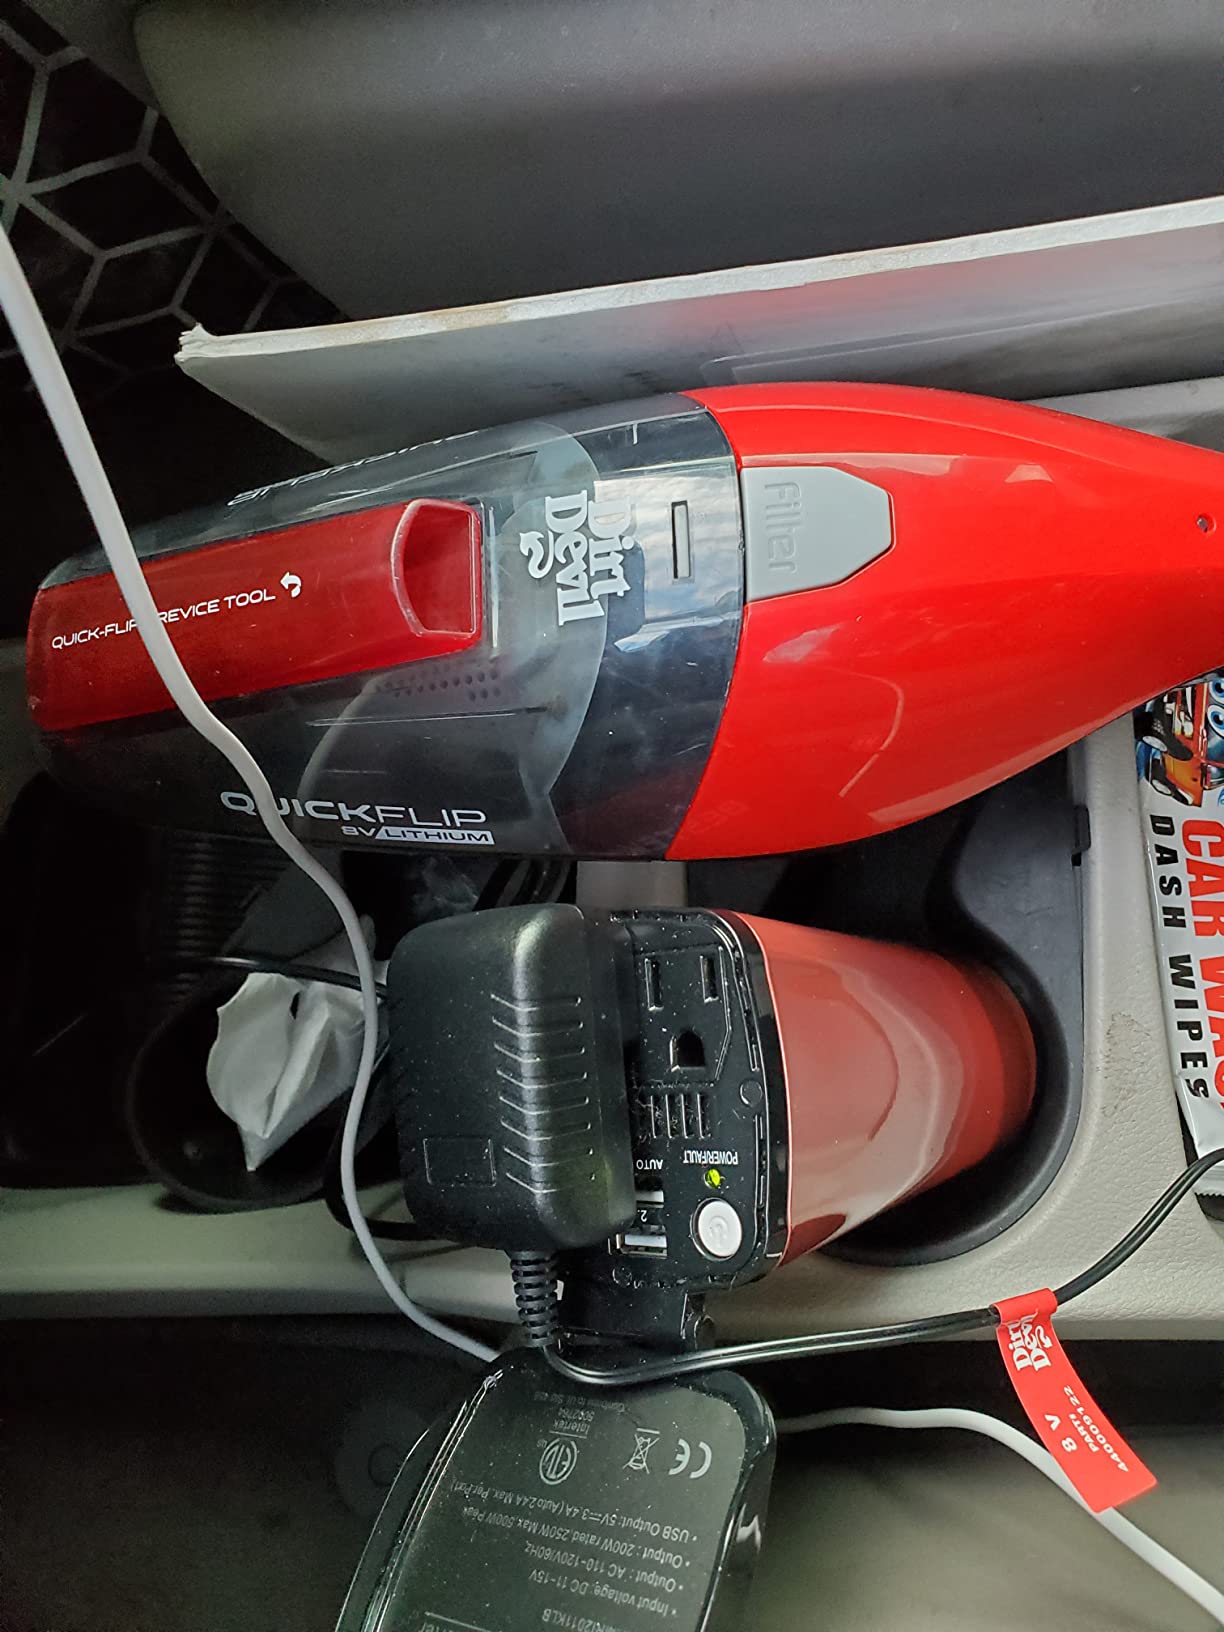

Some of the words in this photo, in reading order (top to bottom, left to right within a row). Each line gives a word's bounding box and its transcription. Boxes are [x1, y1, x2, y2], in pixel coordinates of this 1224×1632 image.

[764, 481, 802, 575] Filter
[588, 499, 635, 597] Dirt
[545, 490, 605, 626] Devil
[157, 599, 220, 624] REVICE
[224, 588, 276, 609] TOOL
[341, 825, 378, 837] 8V
[384, 828, 490, 843] LITHIUM
[1181, 819, 1224, 937] CAR
[1149, 814, 1187, 928] DASH
[1168, 954, 1210, 1098] WIPES
[636, 1159, 664, 1171] AUTO
[553, 1419, 591, 1435] Intertek
[1044, 1413, 1061, 1432] V
[1063, 1384, 1129, 1472] 440009122
[1061, 1437, 1078, 1453] 8
[662, 1527, 690, 1544] USB
[601, 1537, 636, 1557] 200W
[607, 1563, 626, 1580] AC
[570, 1578, 588, 1595] DC
[638, 1597, 670, 1616] Input
